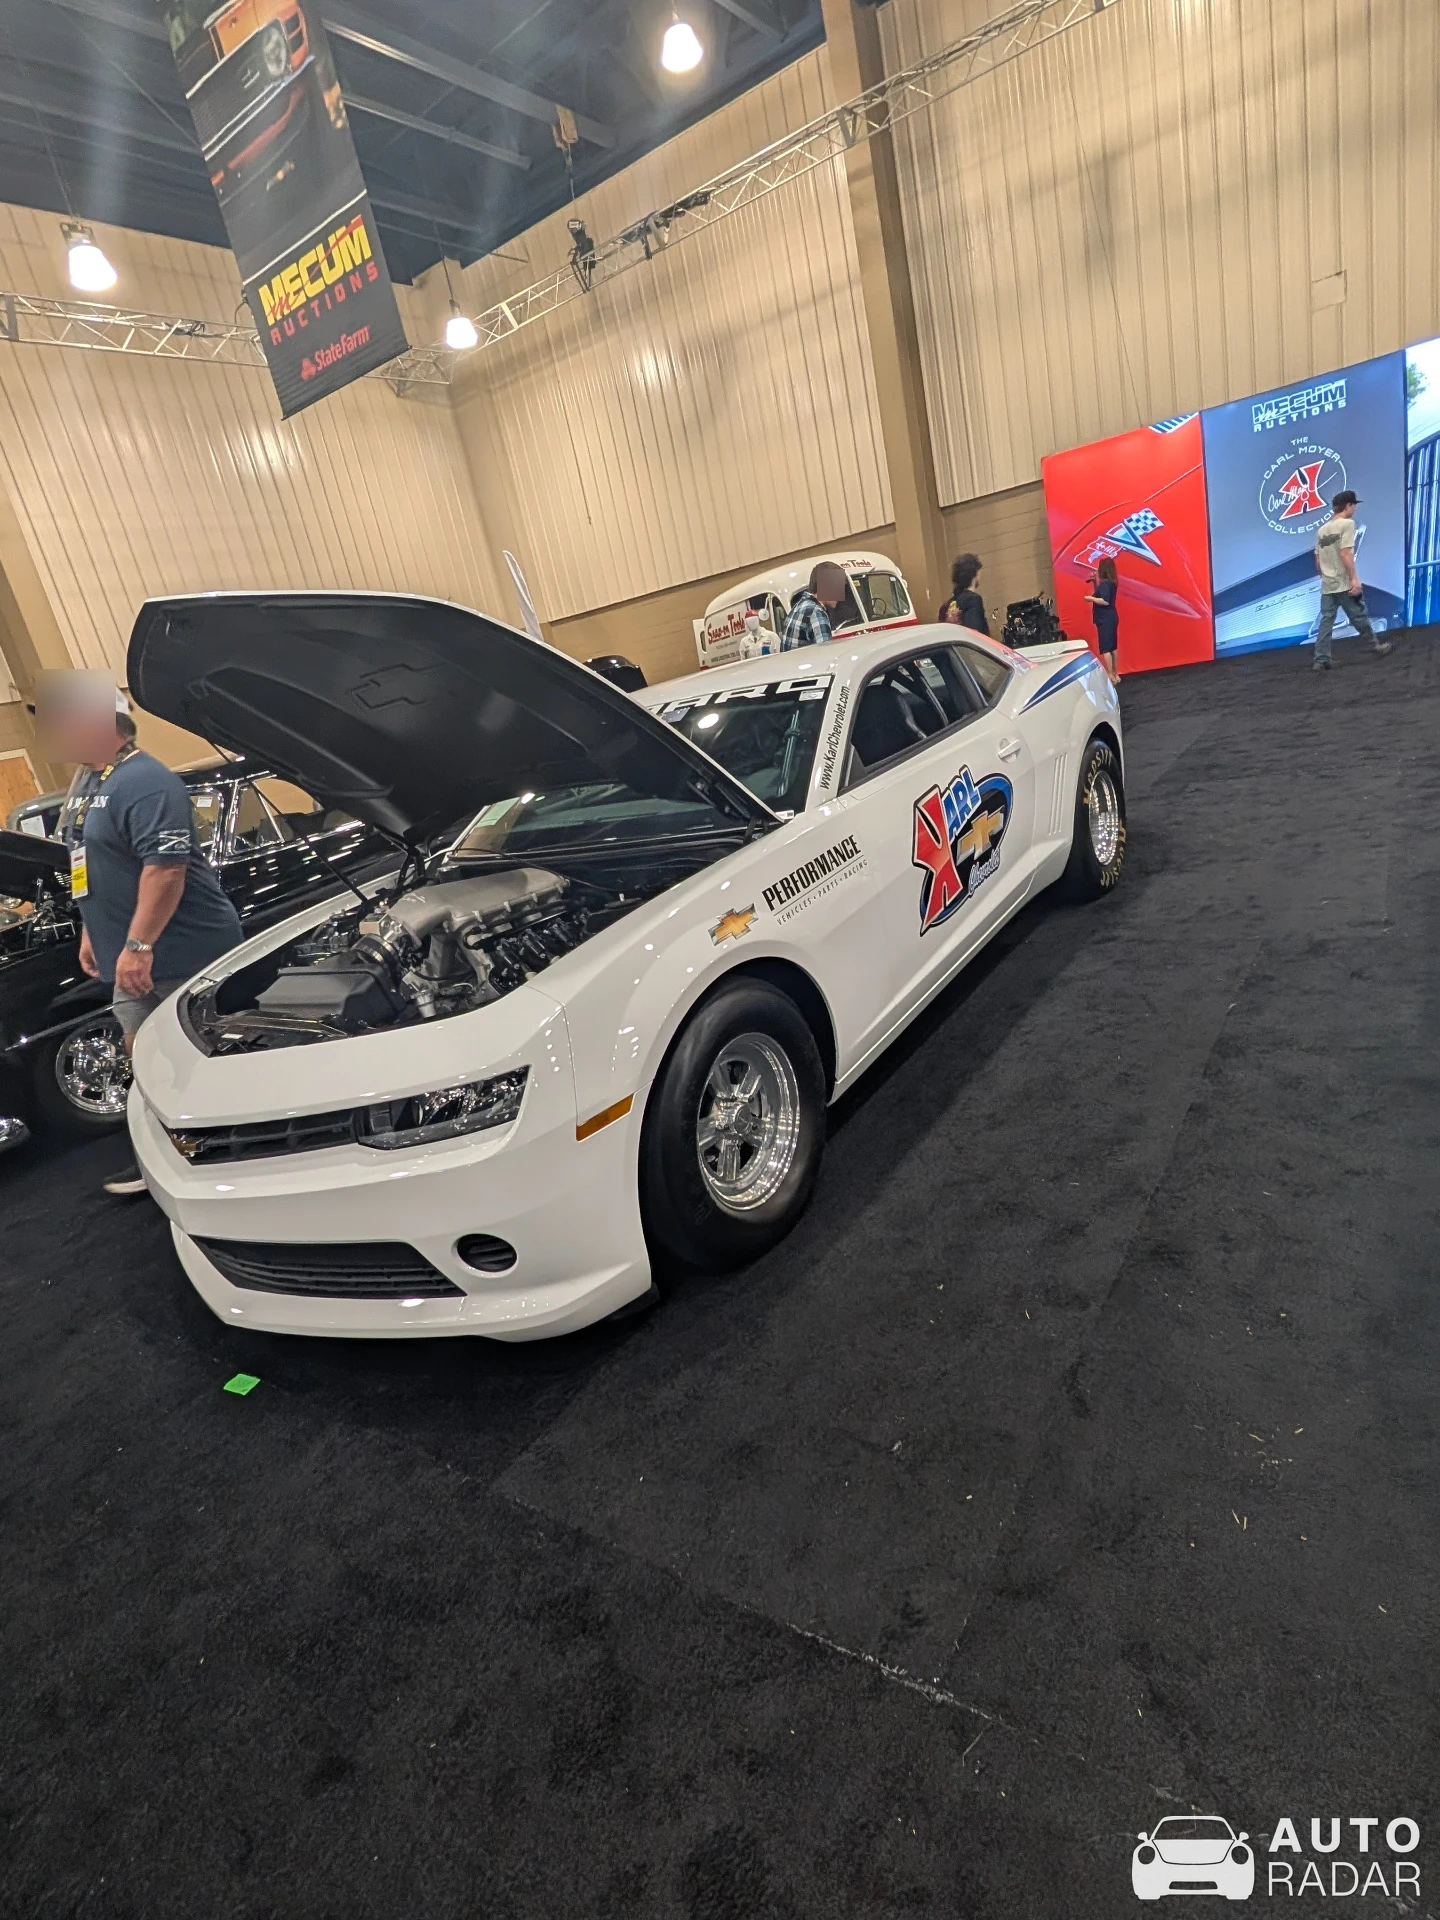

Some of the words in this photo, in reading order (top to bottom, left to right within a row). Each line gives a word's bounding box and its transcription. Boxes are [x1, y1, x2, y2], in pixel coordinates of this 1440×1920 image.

[259, 215, 372, 326] MECUM
[270, 261, 378, 346] AUCTIONS
[1252, 379, 1347, 425] MECUM
[1253, 399, 1347, 433] AUCTIONS
[1264, 453, 1294, 480] CARL
[1298, 445, 1341, 463] MOYER
[1291, 436, 1309, 446] THE
[1268, 510, 1335, 535] COLLECTIO
[646, 675, 833, 714] ARO
[820, 686, 850, 790] www.KarlChevrolet.com
[761, 835, 861, 912] PERFORMANCE
[912, 764, 982, 937] KARL
[777, 897, 812, 926] VEHICLES
[818, 879, 839, 897] PARTS
[843, 859, 868, 880] RACING
